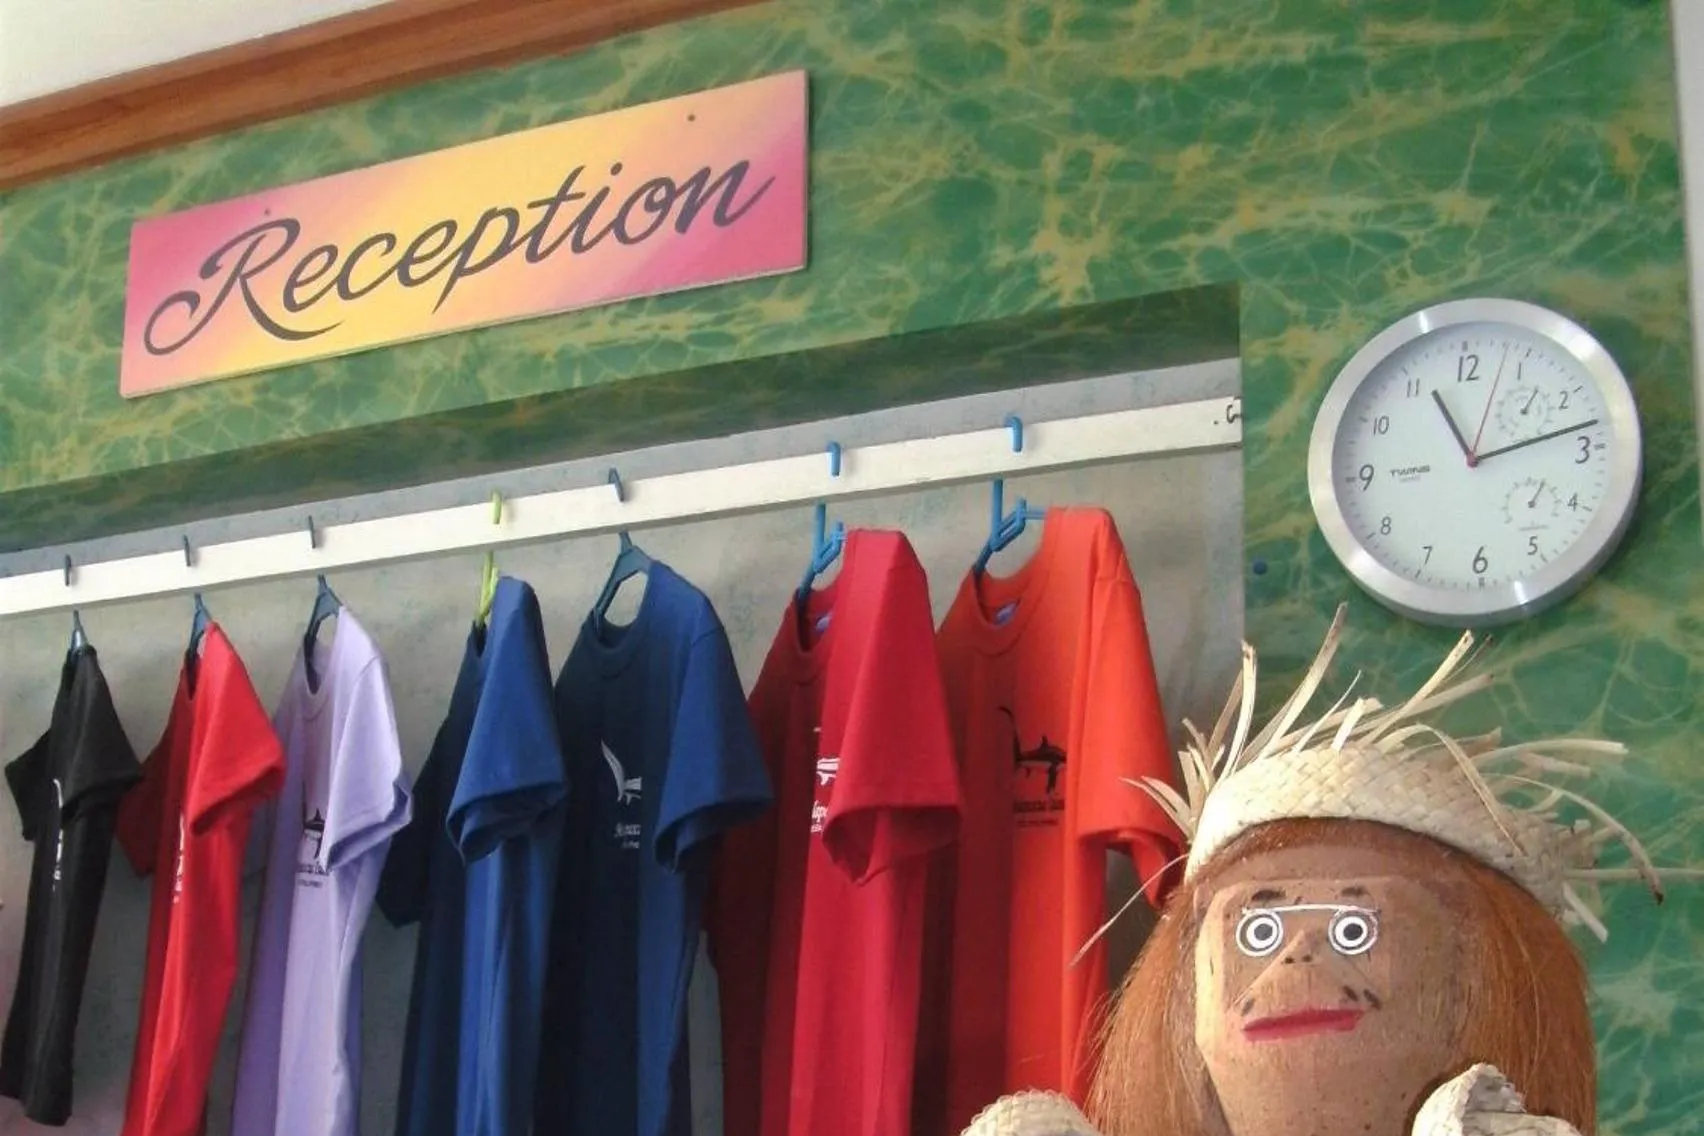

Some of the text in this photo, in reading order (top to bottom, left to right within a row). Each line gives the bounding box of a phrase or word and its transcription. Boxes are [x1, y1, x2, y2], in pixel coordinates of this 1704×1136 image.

[144, 159, 776, 356] Reception
[1457, 354, 1480, 383] 12
[1406, 379, 1420, 398] 11
[1557, 390, 1569, 410] 2
[1373, 415, 1389, 435] 10
[1575, 436, 1591, 465] 3
[1359, 464, 1374, 491] 9
[1567, 492, 1579, 511] 4
[1380, 516, 1391, 536] 8
[1422, 545, 1433, 564] 7
[1527, 536, 1539, 555] 5
[1472, 546, 1488, 574] 6
